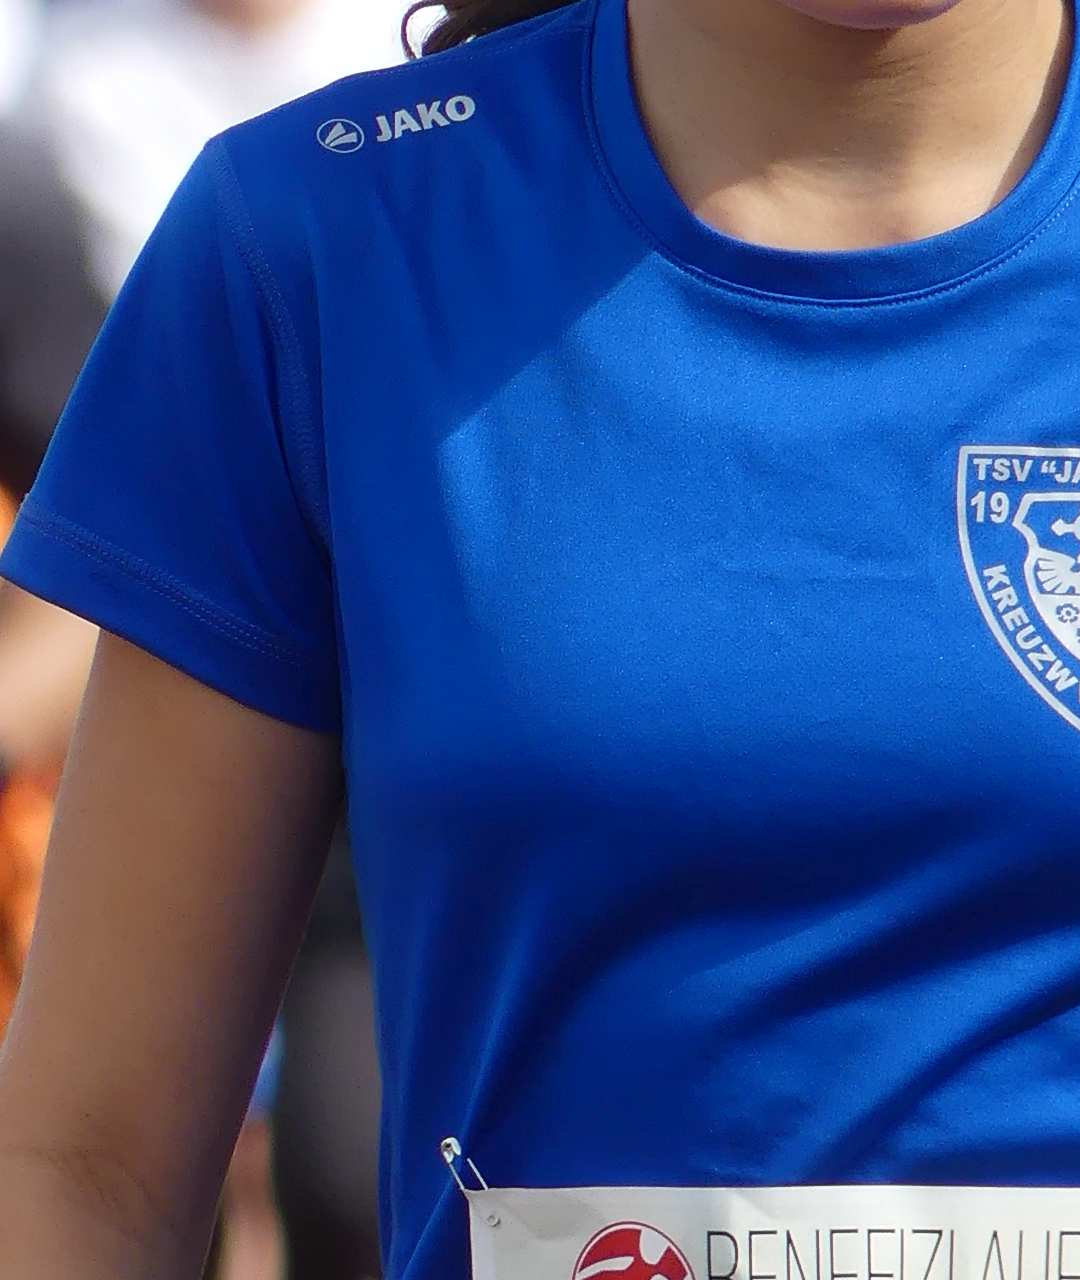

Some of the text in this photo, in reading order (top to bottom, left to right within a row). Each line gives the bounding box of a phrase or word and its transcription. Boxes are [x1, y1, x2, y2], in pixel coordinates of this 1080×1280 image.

[375, 95, 476, 142] JAKO
[972, 458, 1033, 482] TSV
[970, 491, 1009, 523] 19
